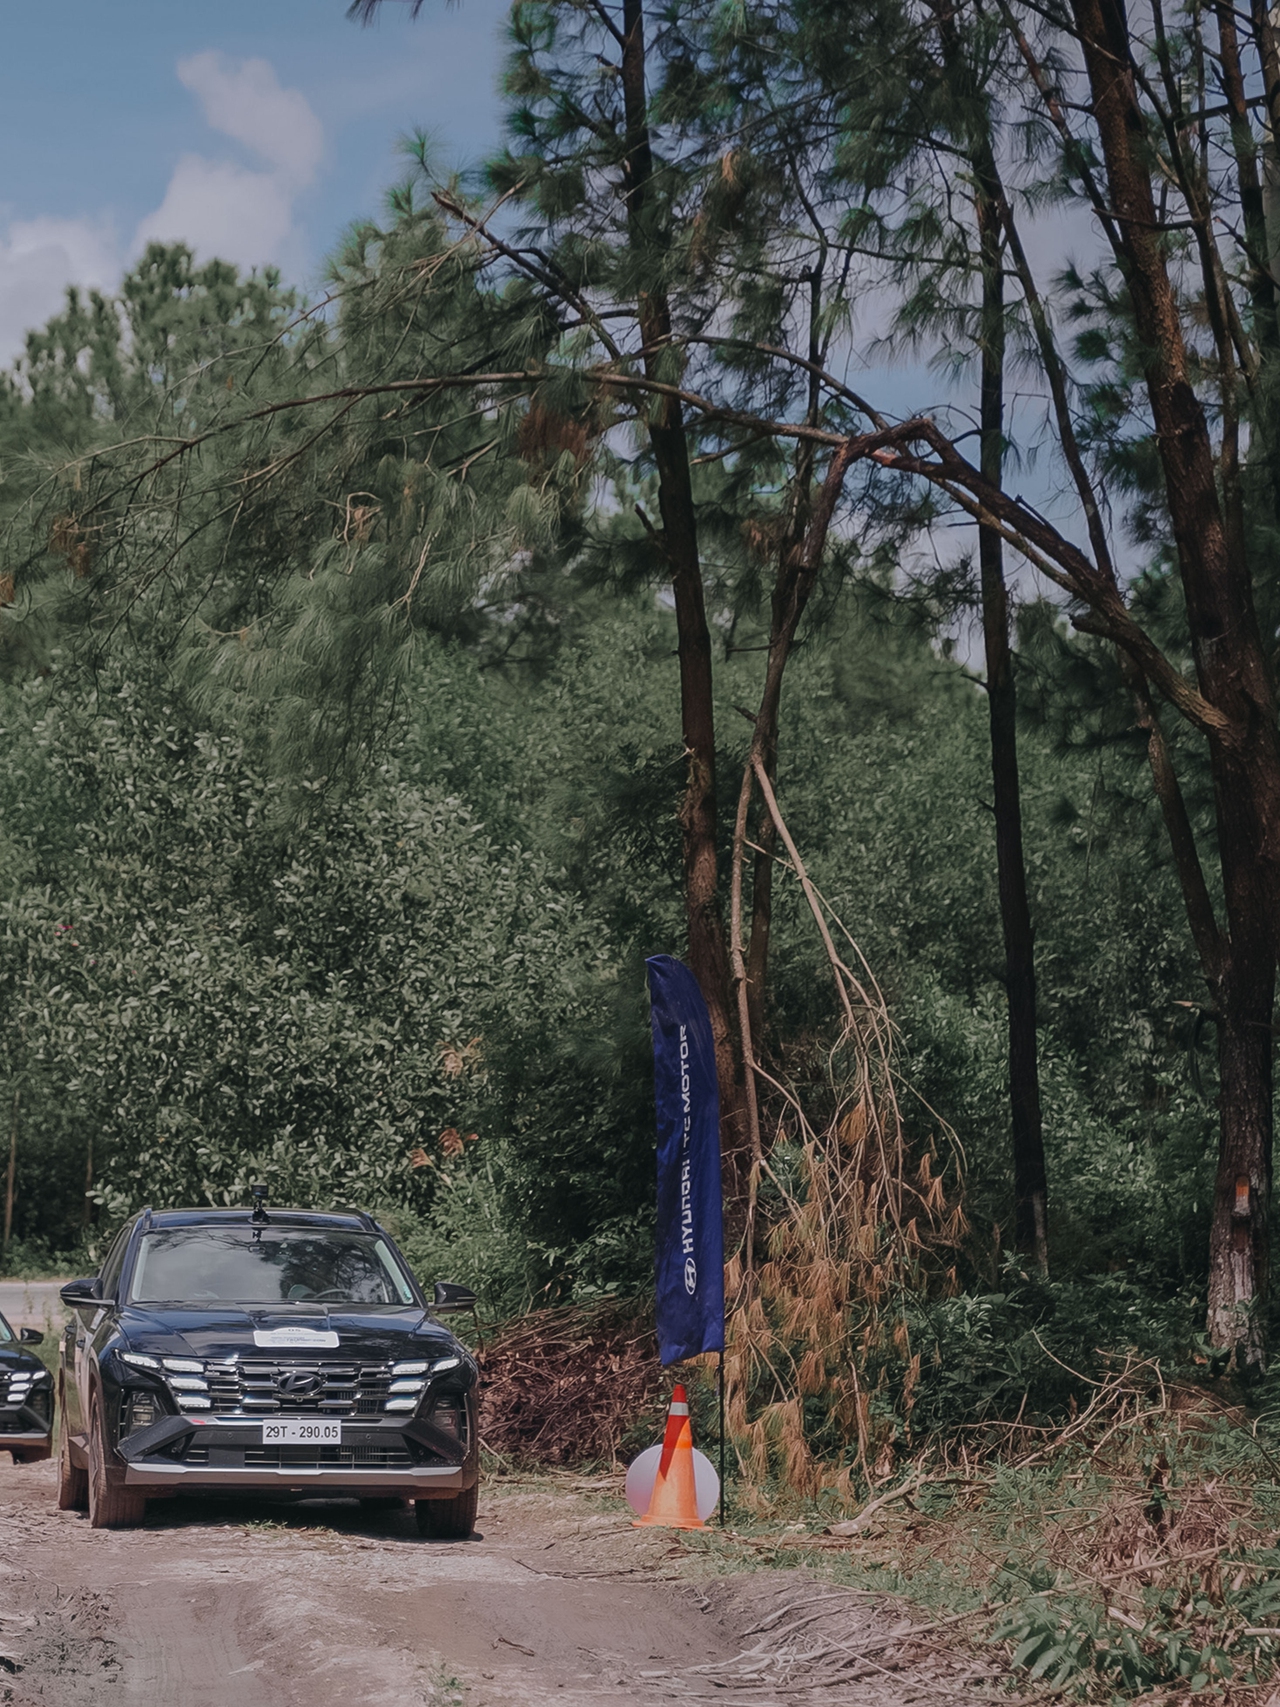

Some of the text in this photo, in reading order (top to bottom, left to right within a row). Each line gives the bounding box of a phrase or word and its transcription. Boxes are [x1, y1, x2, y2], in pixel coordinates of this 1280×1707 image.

[679, 1024, 694, 1254] HYUNDAI TC MOTOR
[266, 1426, 288, 1438] 29T
[299, 1426, 339, 1438] 290.05
